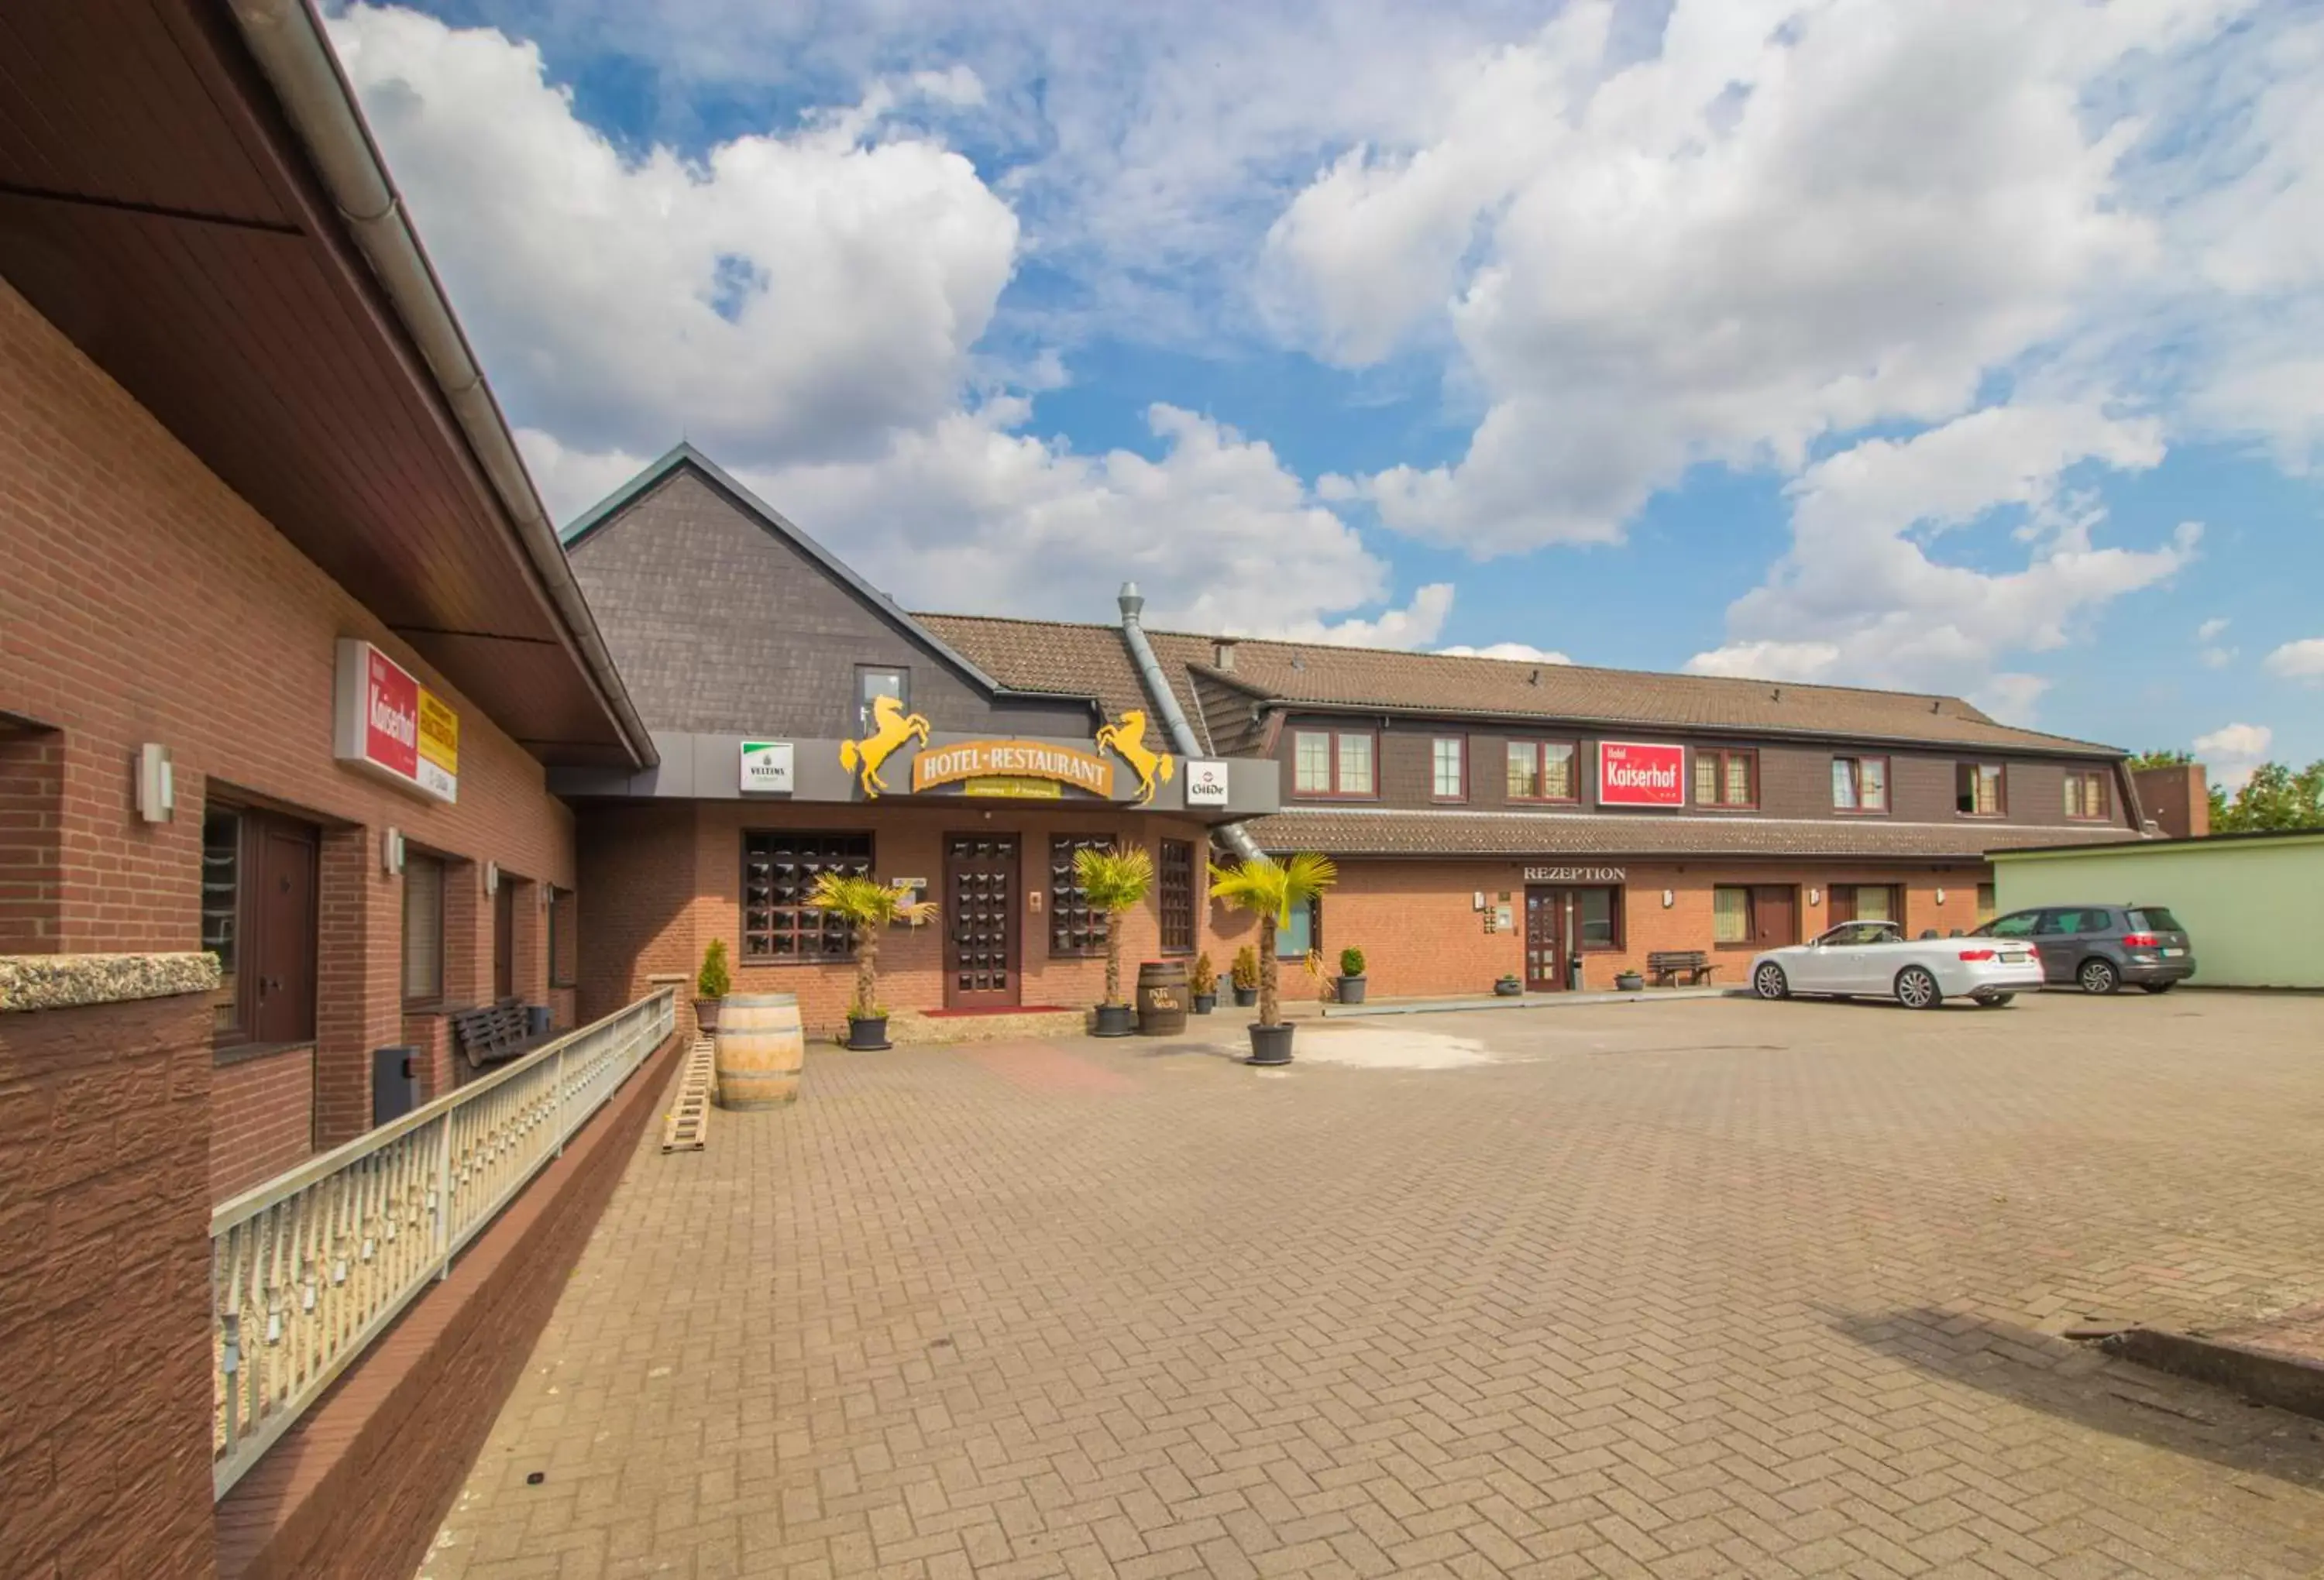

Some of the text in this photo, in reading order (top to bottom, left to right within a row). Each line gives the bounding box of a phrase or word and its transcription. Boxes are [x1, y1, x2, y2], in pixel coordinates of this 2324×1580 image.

[371, 683, 415, 749] Kaiserhof
[924, 747, 1106, 786] HOTEL RESTAURANT
[1607, 761, 1676, 788] Kaiserhof
[1524, 867, 1625, 880] REZEPTION
